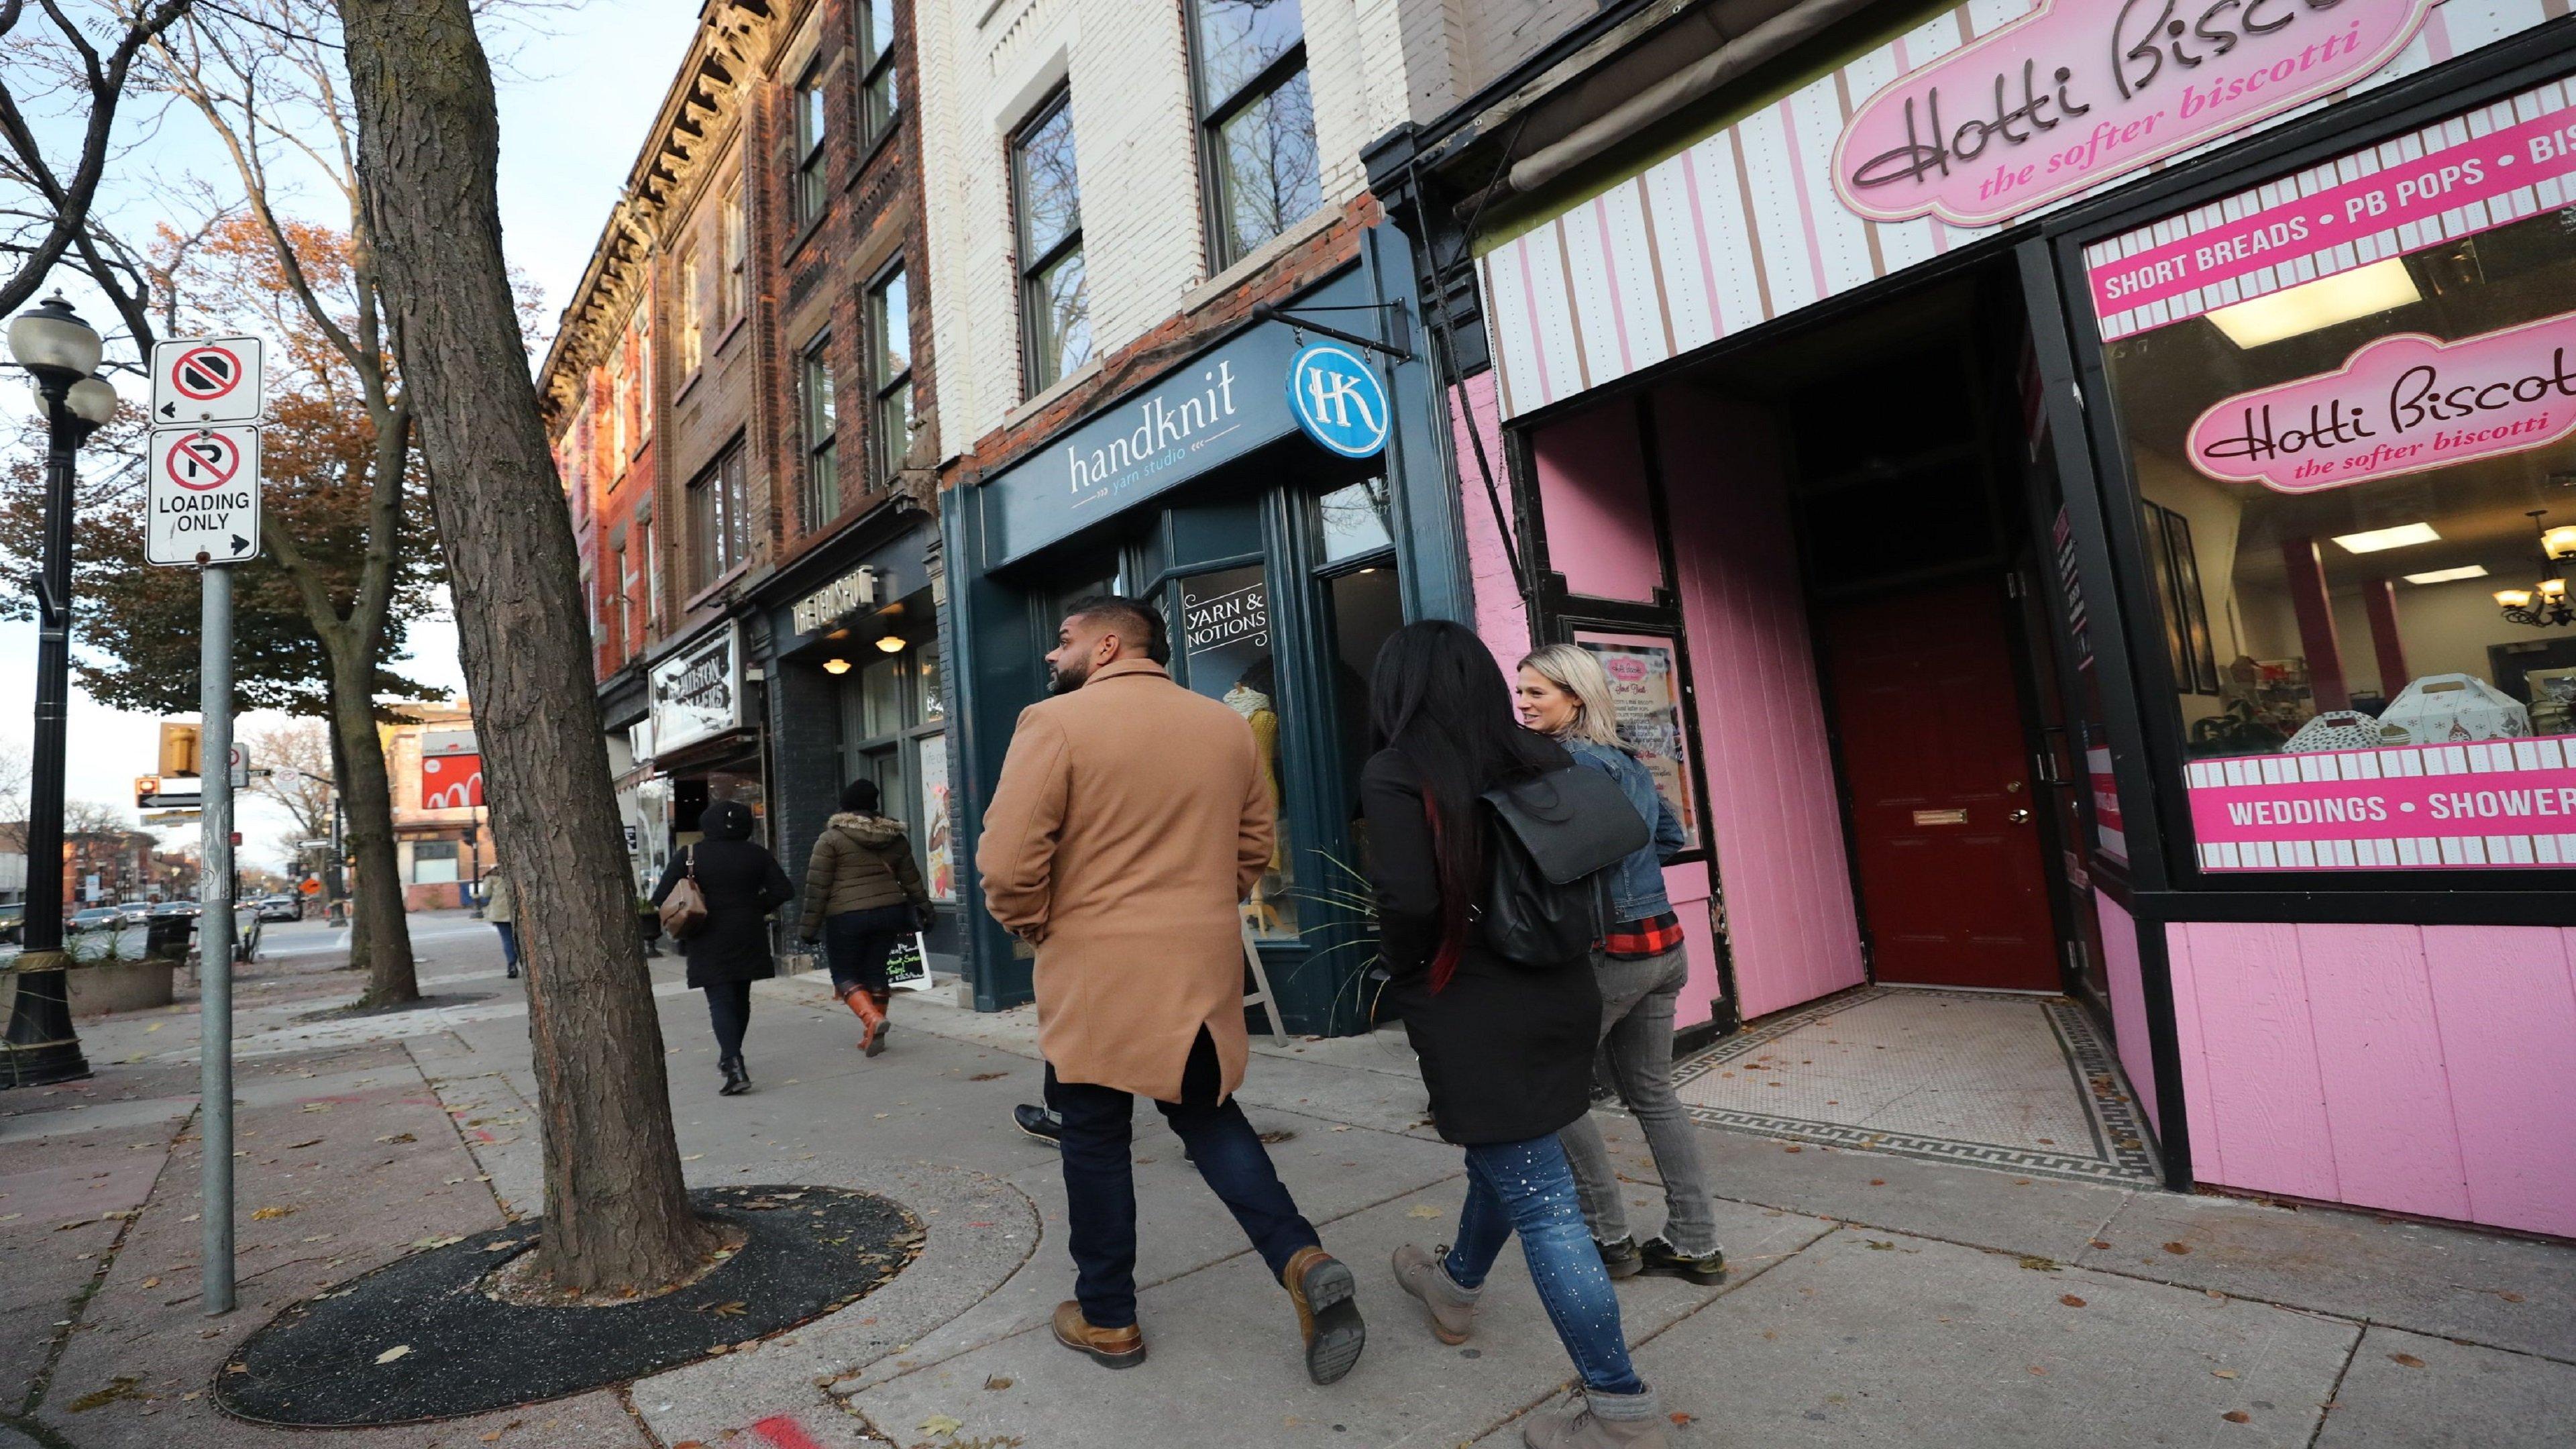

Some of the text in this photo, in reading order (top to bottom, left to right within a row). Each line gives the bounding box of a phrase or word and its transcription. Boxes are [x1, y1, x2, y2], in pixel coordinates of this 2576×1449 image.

[1852, 0, 2341, 186] Hotti Bisc
[1978, 20, 2360, 201] the softer biscotti
[2104, 254, 2187, 300] SHORT
[2196, 215, 2308, 272] BREADS
[2345, 189, 2388, 223] PB
[2396, 158, 2484, 204] POPS
[1069, 360, 1236, 493] handknit
[1307, 366, 1384, 434] HK
[2204, 399, 2375, 462] Hotti
[1112, 446, 1185, 495] yarn studio
[2295, 412, 2549, 479] the softer biscotti
[160, 492, 249, 513] LOADING
[178, 513, 229, 531] ONLY
[1187, 593, 1265, 629] YARN &
[1187, 611, 1266, 648] NOTIONS
[2227, 788, 2576, 826] WEDDINGS SHOWER
